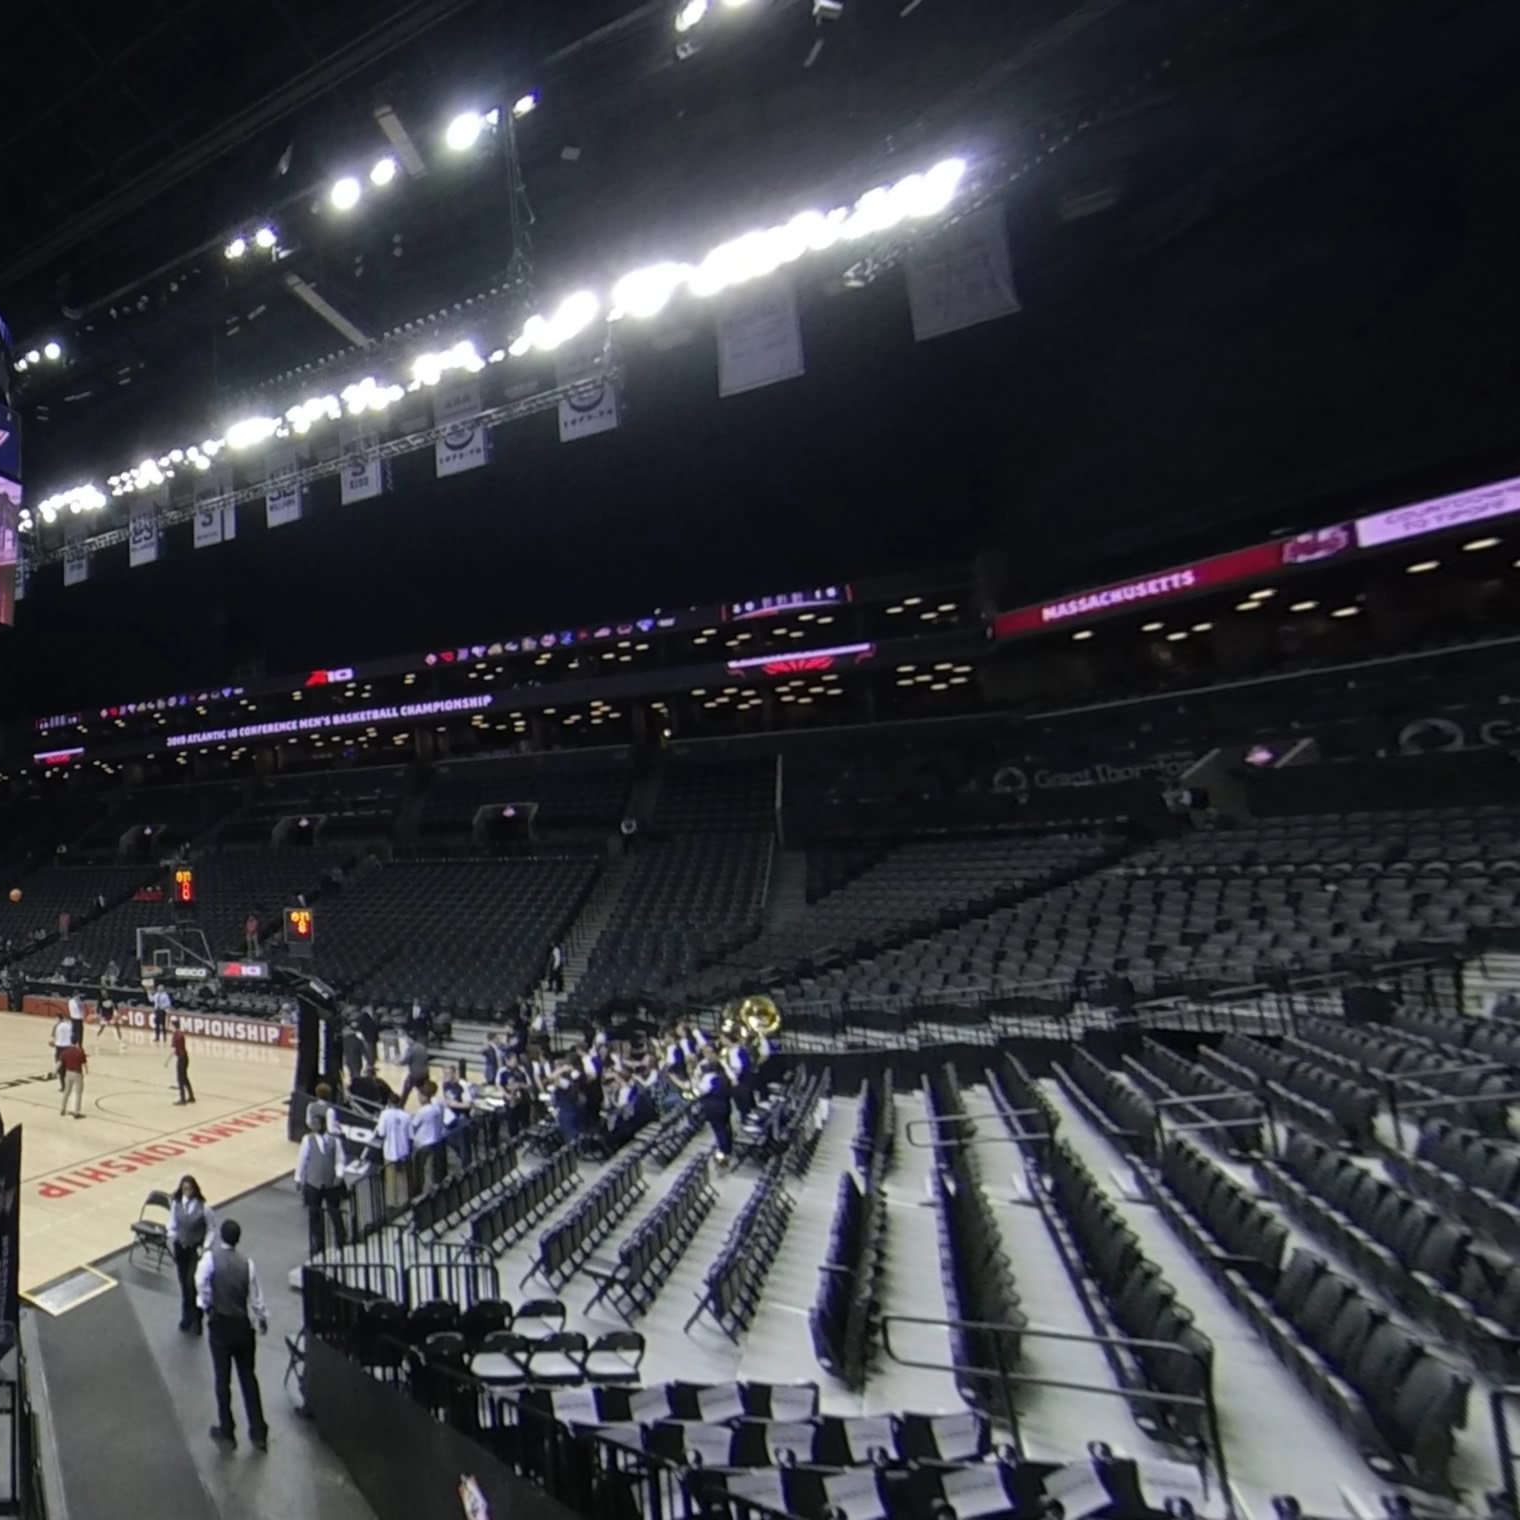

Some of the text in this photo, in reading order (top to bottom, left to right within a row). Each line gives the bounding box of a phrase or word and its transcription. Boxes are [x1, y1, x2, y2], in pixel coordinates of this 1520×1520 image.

[1041, 570, 1195, 621] MASSACHUSETTS
[305, 668, 353, 686] A10
[186, 730, 226, 744] ATLANTIC
[239, 720, 298, 737] CONFERENCE
[299, 715, 331, 729] MEN'S
[332, 707, 399, 725] BASKETBALL
[400, 695, 493, 718] CHAMPIONSHIP
[176, 967, 207, 977] GEICO
[122, 1012, 280, 1043] -10 CMPIONSHIP
[38, 1107, 289, 1199] CHAMPIONSHIP
